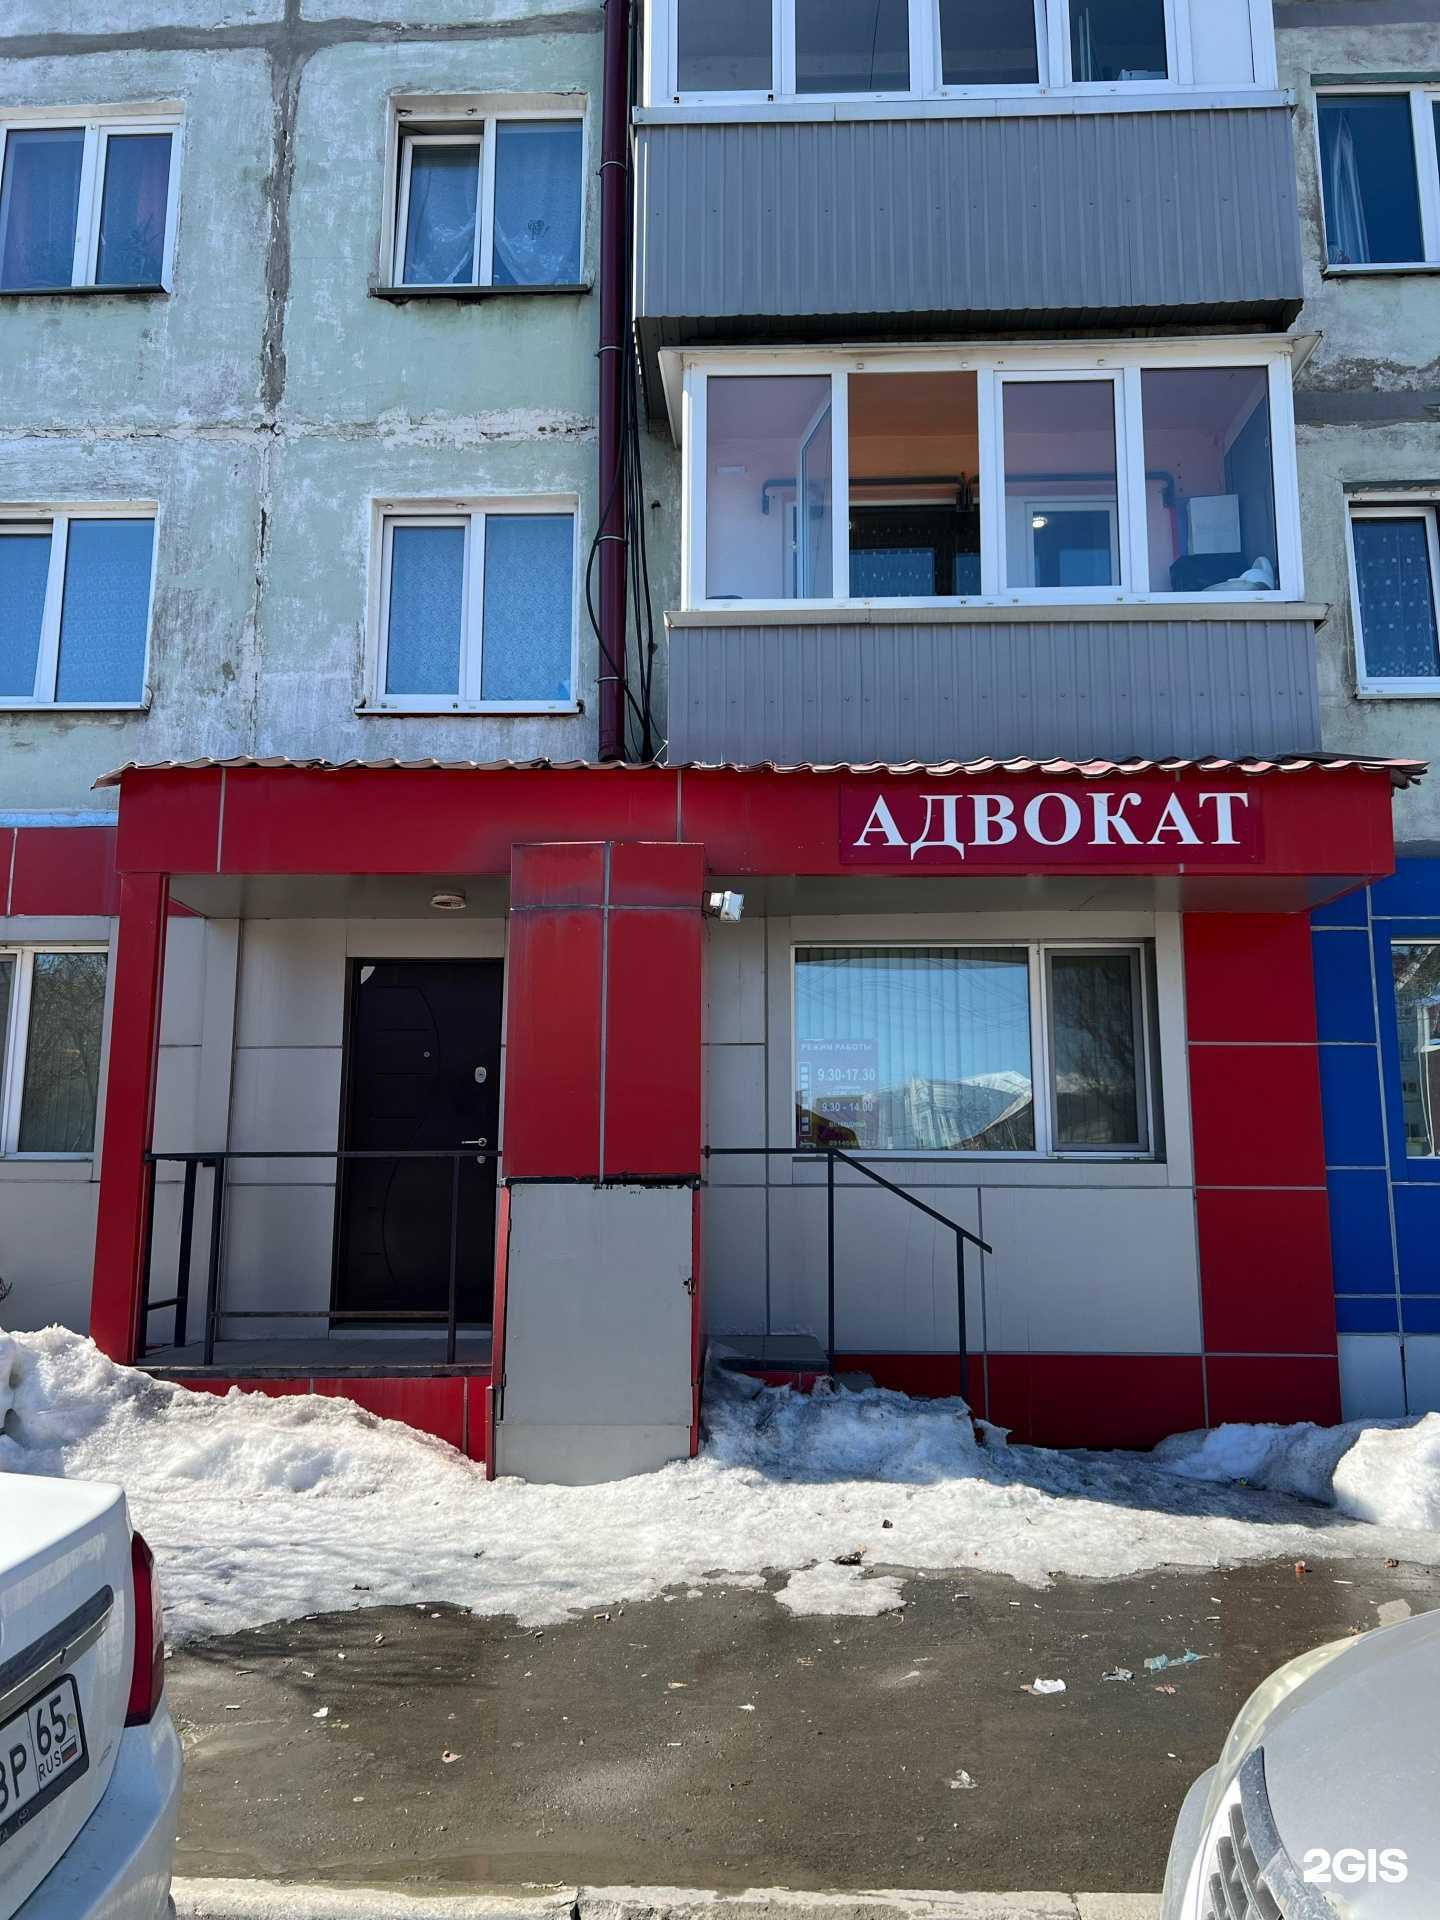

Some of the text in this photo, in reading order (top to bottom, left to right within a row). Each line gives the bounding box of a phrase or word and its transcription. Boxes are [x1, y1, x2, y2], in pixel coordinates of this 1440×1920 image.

[853, 792, 1249, 860] АДВОКАТ
[36, 1695, 67, 1756] 65
[38, 1750, 62, 1782] RUS
